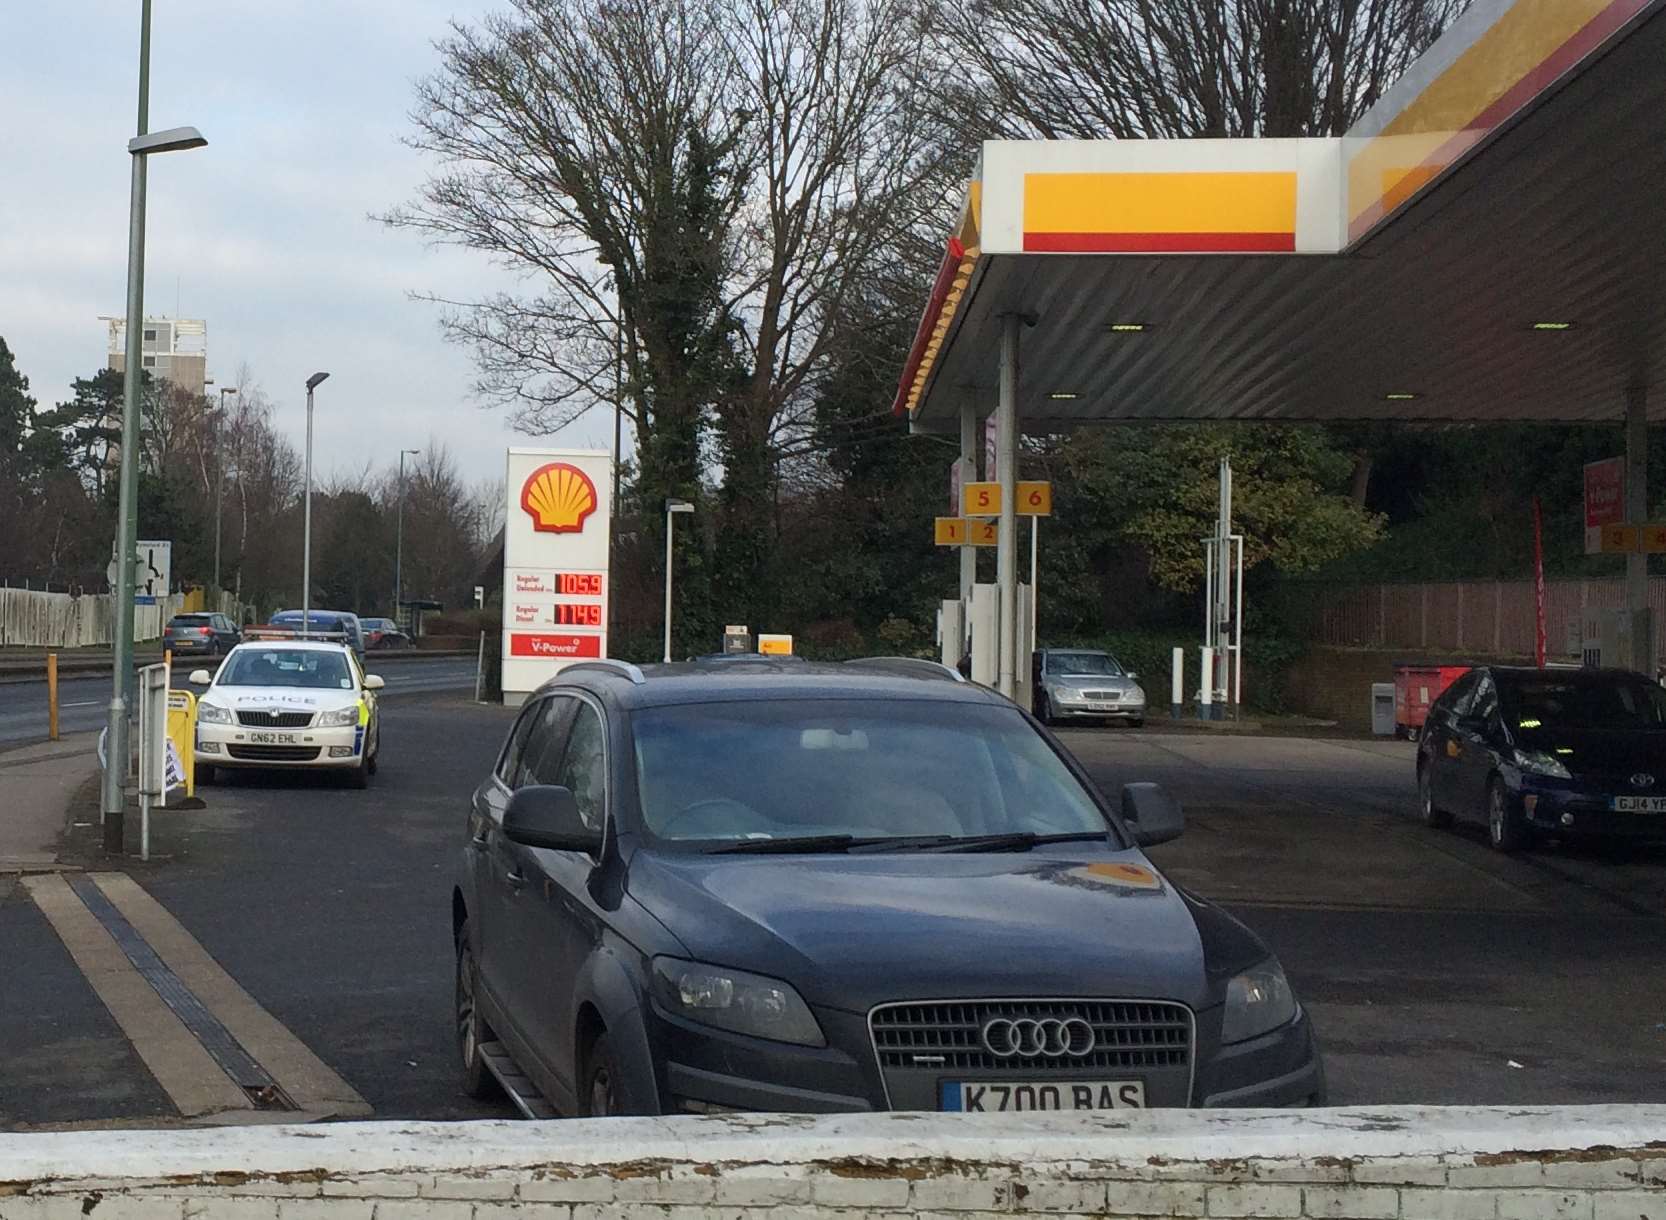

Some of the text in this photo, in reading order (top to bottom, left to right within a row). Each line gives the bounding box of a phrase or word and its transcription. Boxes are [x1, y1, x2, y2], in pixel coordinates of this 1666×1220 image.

[977, 490, 990, 507] 5
[1028, 490, 1042, 507] 6
[983, 525, 994, 539] 2
[531, 642, 577, 653] V-Power
[238, 695, 317, 705] POLICE
[250, 733, 297, 744] GN62 EHL
[1619, 798, 1649, 810] GJ14
